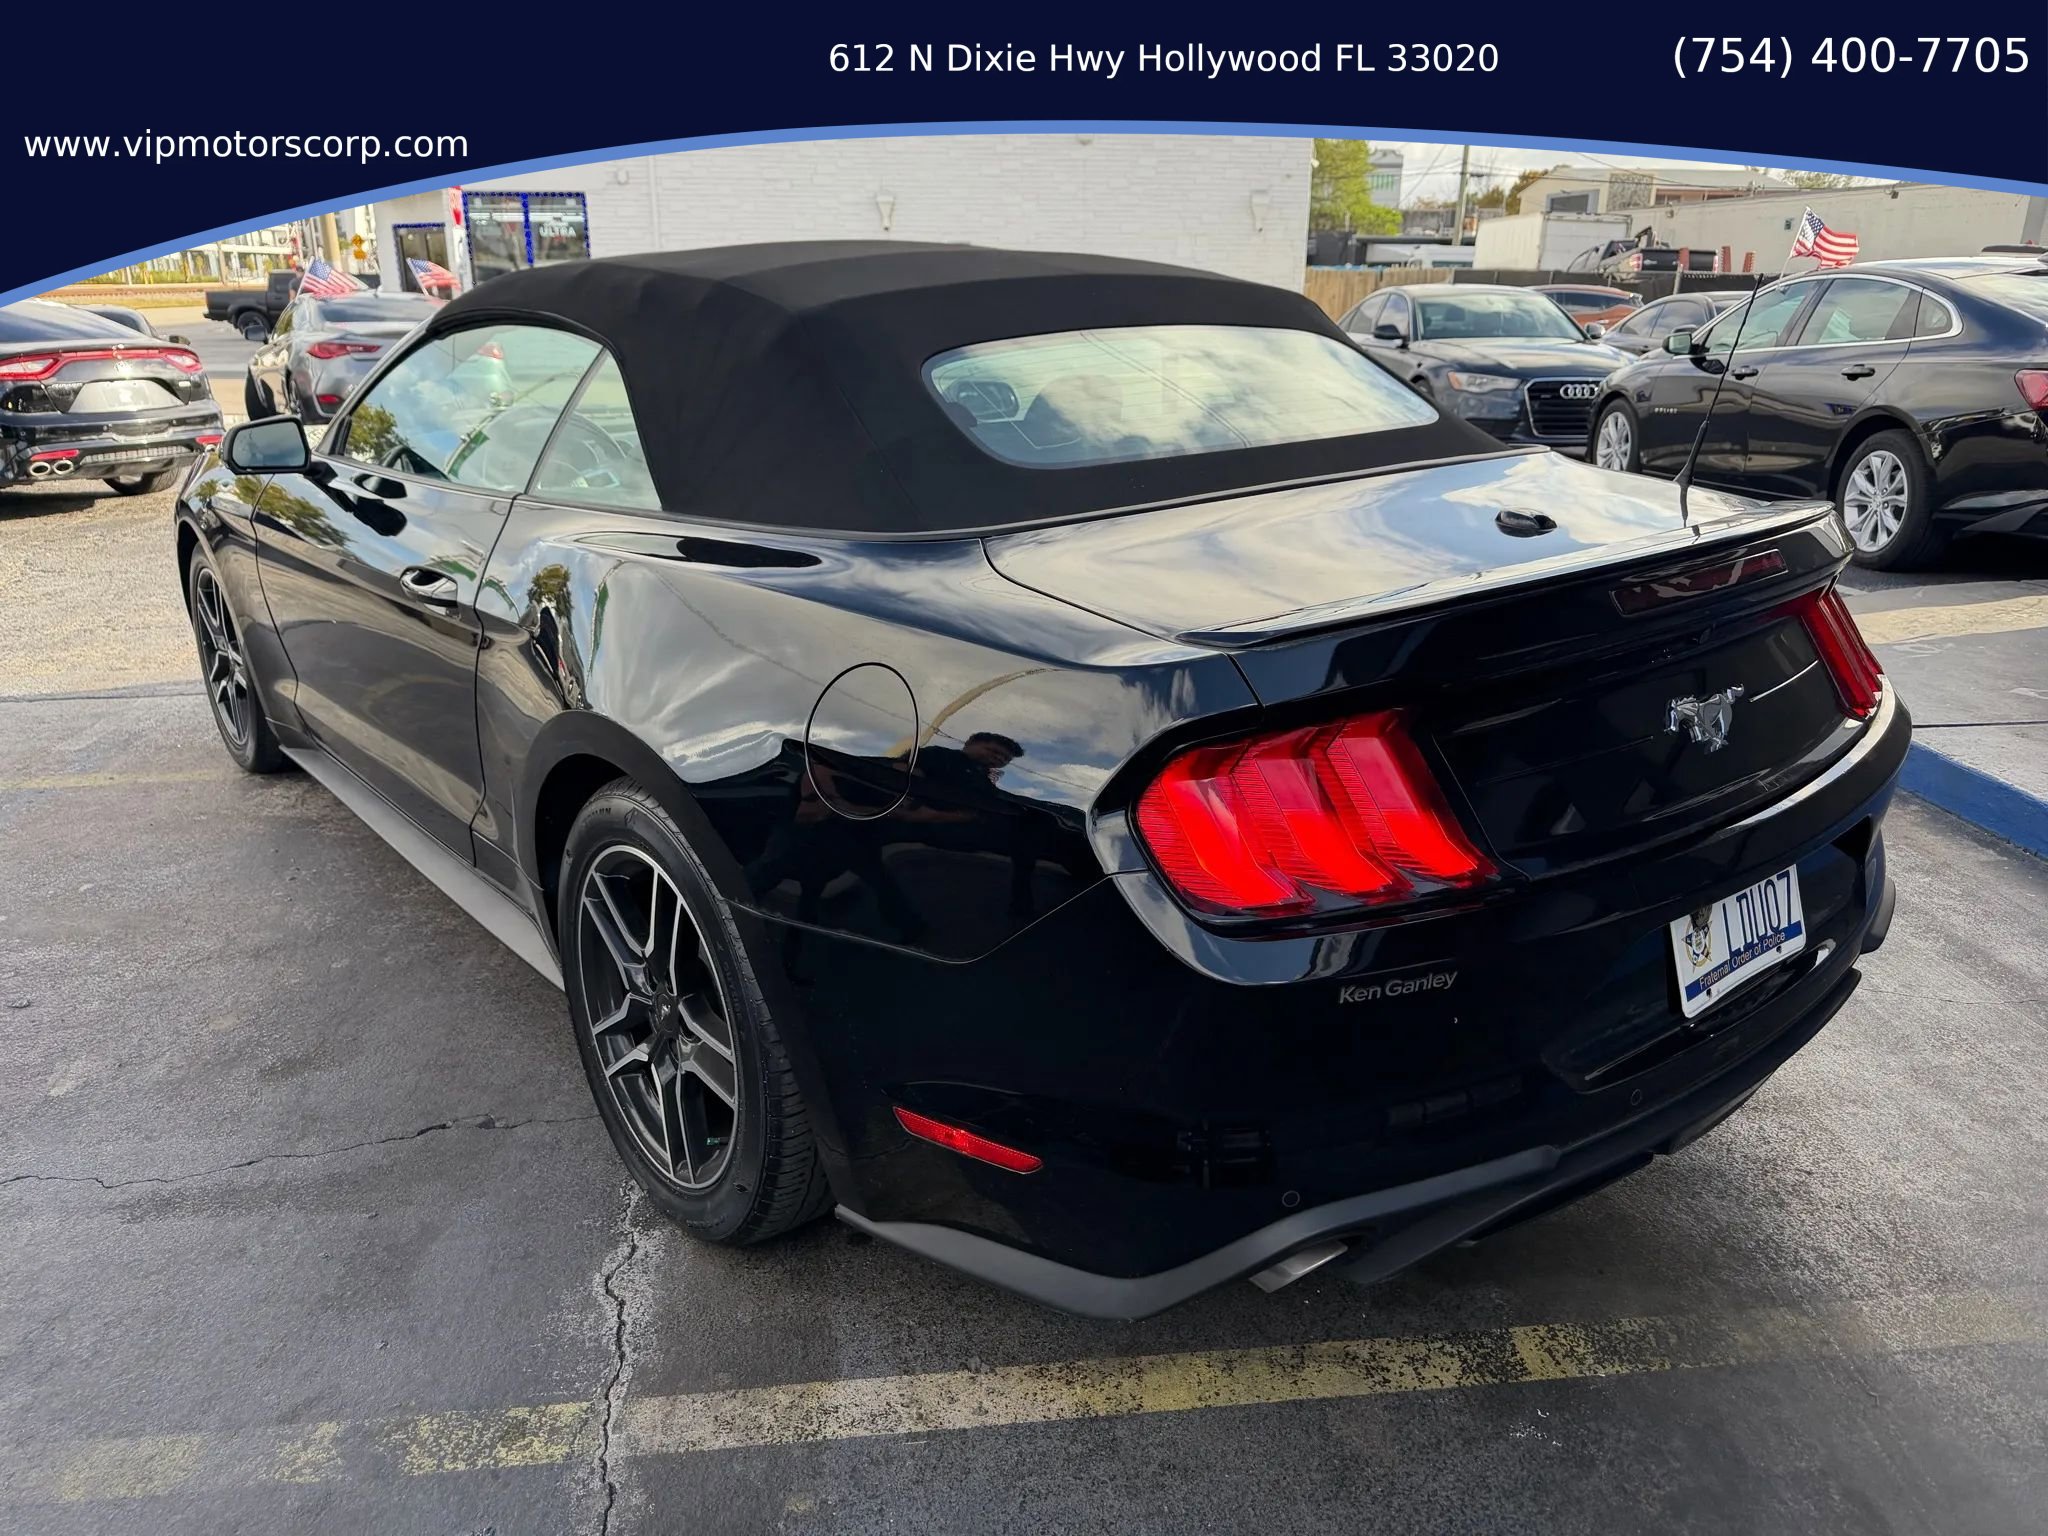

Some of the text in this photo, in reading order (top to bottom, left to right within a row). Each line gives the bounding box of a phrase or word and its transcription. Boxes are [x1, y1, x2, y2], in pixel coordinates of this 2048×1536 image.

[1699, 931, 1786, 990] Fraternal Order of Police
[1339, 971, 1458, 1004] Ken Ganley
